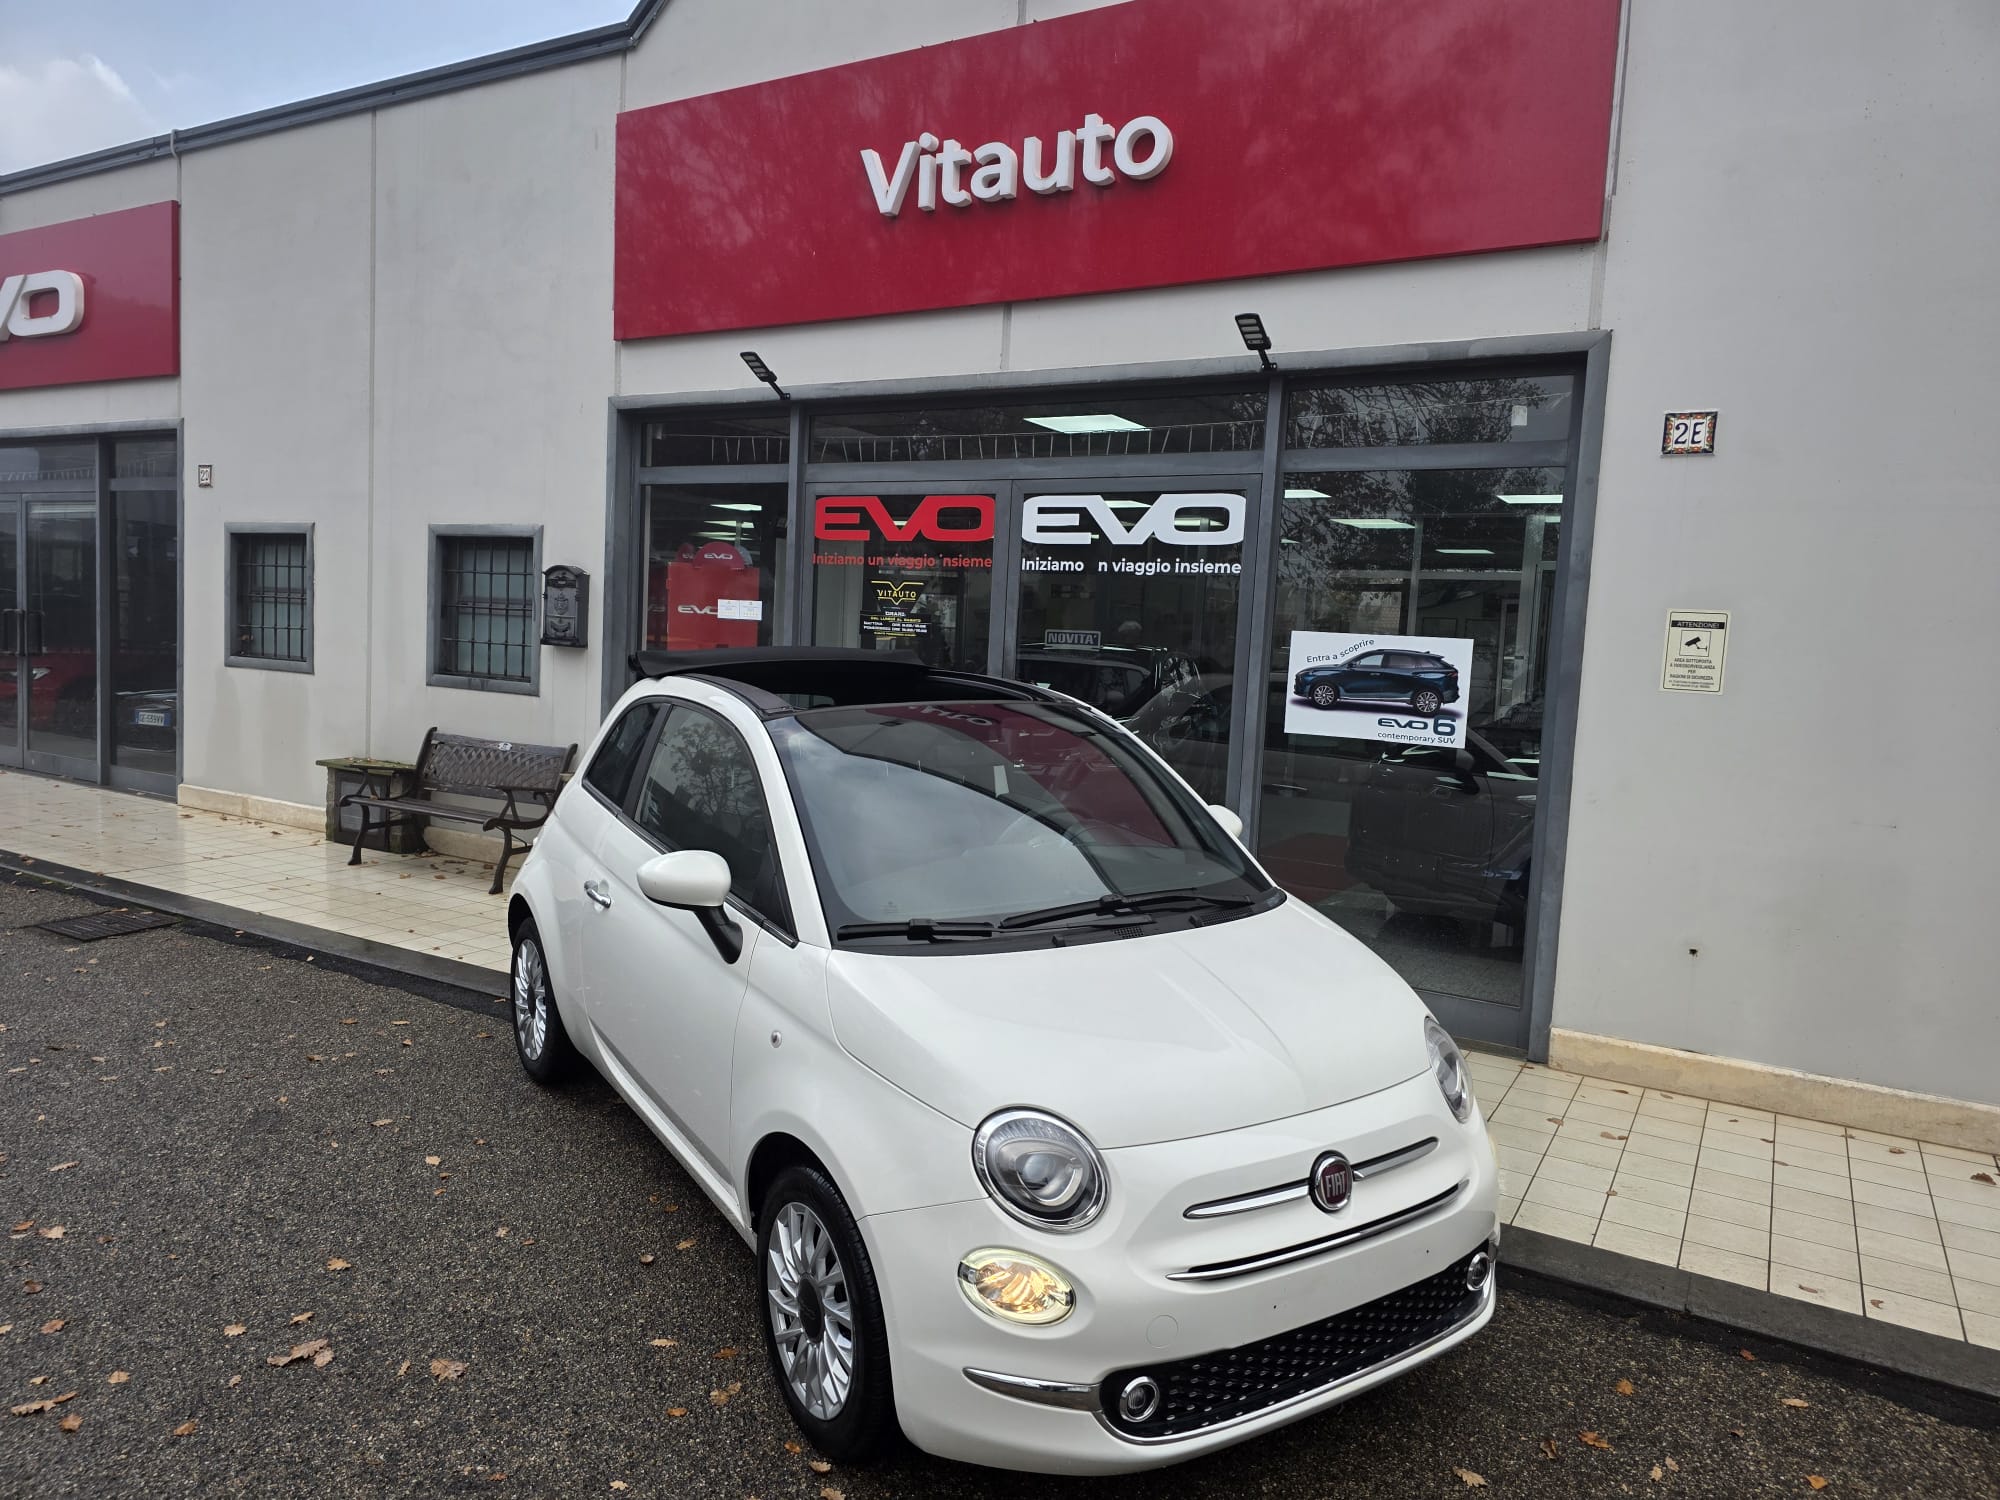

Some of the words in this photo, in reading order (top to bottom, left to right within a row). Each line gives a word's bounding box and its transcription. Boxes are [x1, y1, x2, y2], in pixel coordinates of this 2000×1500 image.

[860, 113, 1174, 216] Vitauto
[1674, 421, 1705, 445] 2E
[814, 495, 995, 542] EVO
[1022, 493, 1247, 545] EVO
[704, 552, 733, 560] EVO
[812, 552, 864, 566] Iniziamo
[868, 555, 884, 566] un
[887, 553, 936, 569] viaggio
[939, 553, 992, 568] nsieme
[1021, 556, 1085, 572] Iniziamo
[1112, 557, 1171, 576] viaggio
[1174, 557, 1242, 574] insieme
[877, 590, 916, 598] VITAUTO
[1307, 654, 1331, 663] Entra
[1340, 639, 1375, 658] scoprire
[1377, 717, 1428, 730] EVO
[1433, 715, 1457, 737] 6
[1377, 731, 1436, 744] contemporary
[1437, 735, 1456, 745] SUV
[1325, 1170, 1346, 1198] FIAT
